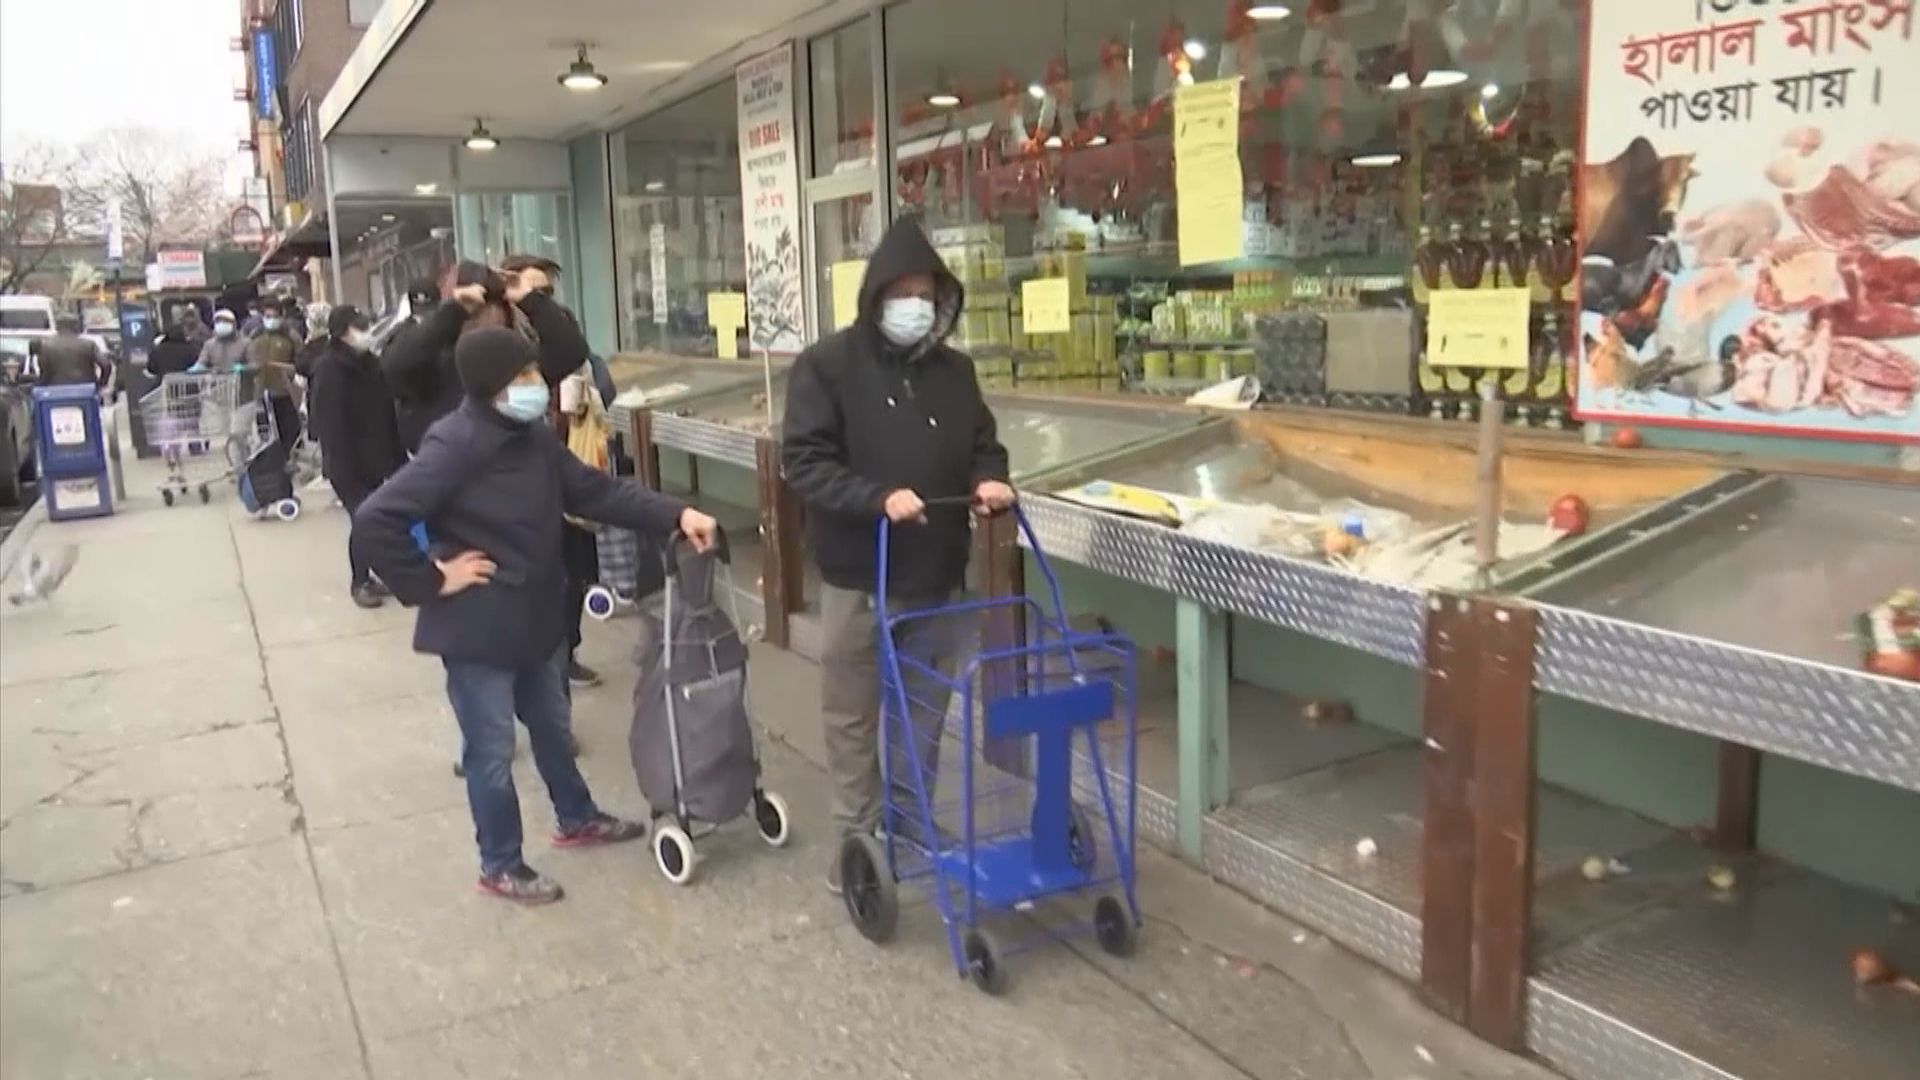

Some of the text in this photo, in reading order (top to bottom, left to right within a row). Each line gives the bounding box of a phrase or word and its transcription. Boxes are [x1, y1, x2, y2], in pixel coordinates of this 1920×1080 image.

[1620, 0, 1912, 87] হালাল মাংস
[1640, 79, 1760, 129] পাওয়া
[1771, 67, 1856, 114] যায়
[131, 321, 142, 337] P
